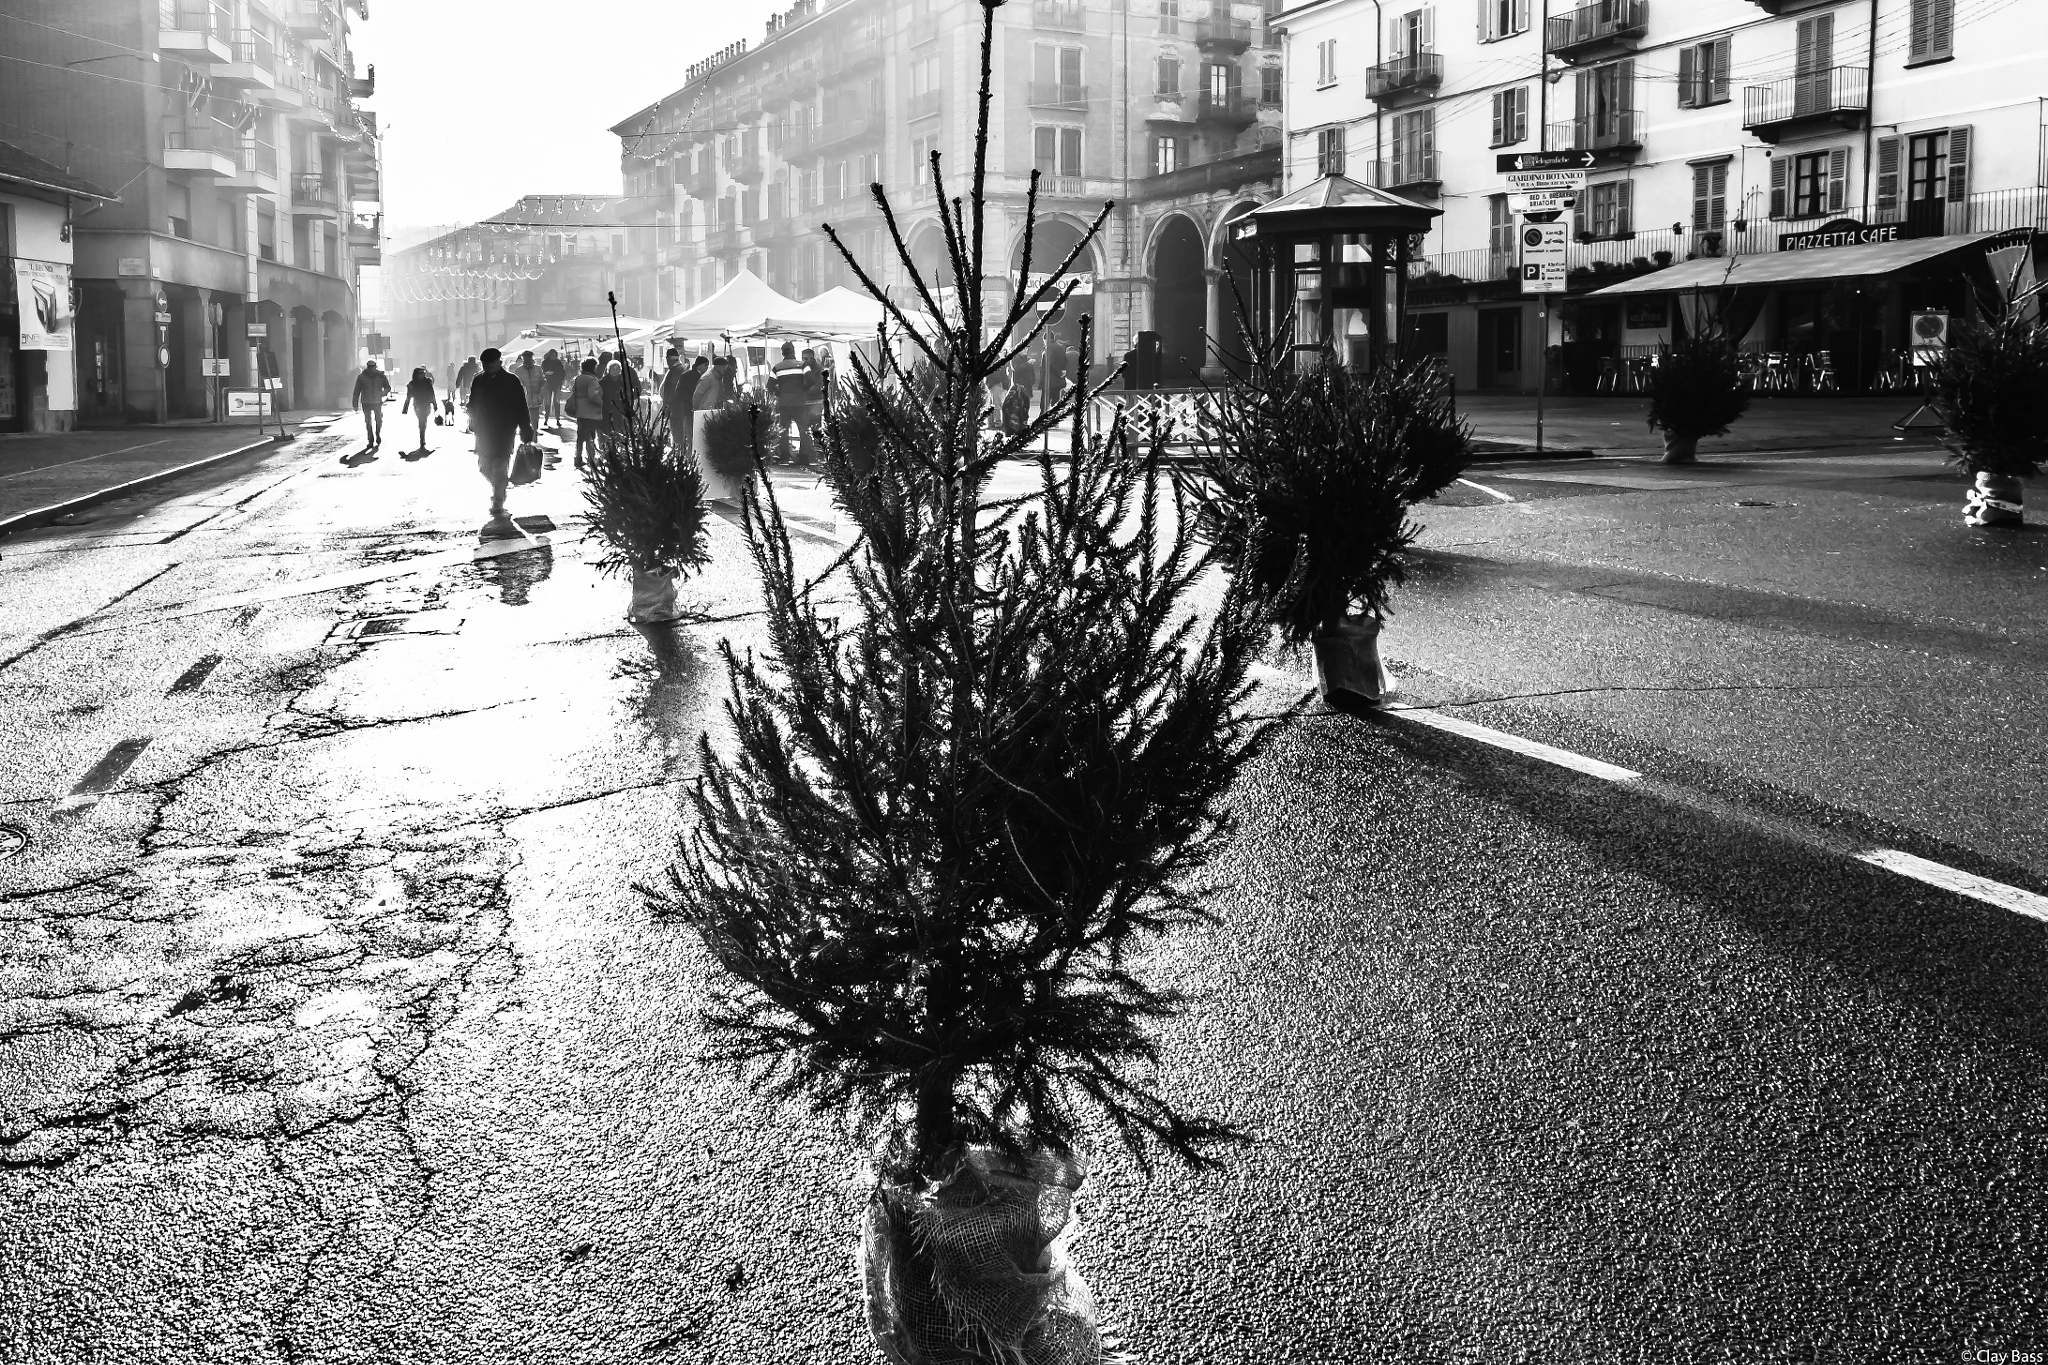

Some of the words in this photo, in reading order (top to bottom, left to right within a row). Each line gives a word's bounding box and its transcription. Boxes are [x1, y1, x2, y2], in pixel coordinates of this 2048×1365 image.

[1508, 174, 1545, 182] GIARDINO
[1546, 172, 1583, 180] BOTANICO
[1530, 199, 1557, 207] BRIATORE
[1786, 231, 1856, 251] PIAZZETTA
[1527, 266, 1537, 278] P
